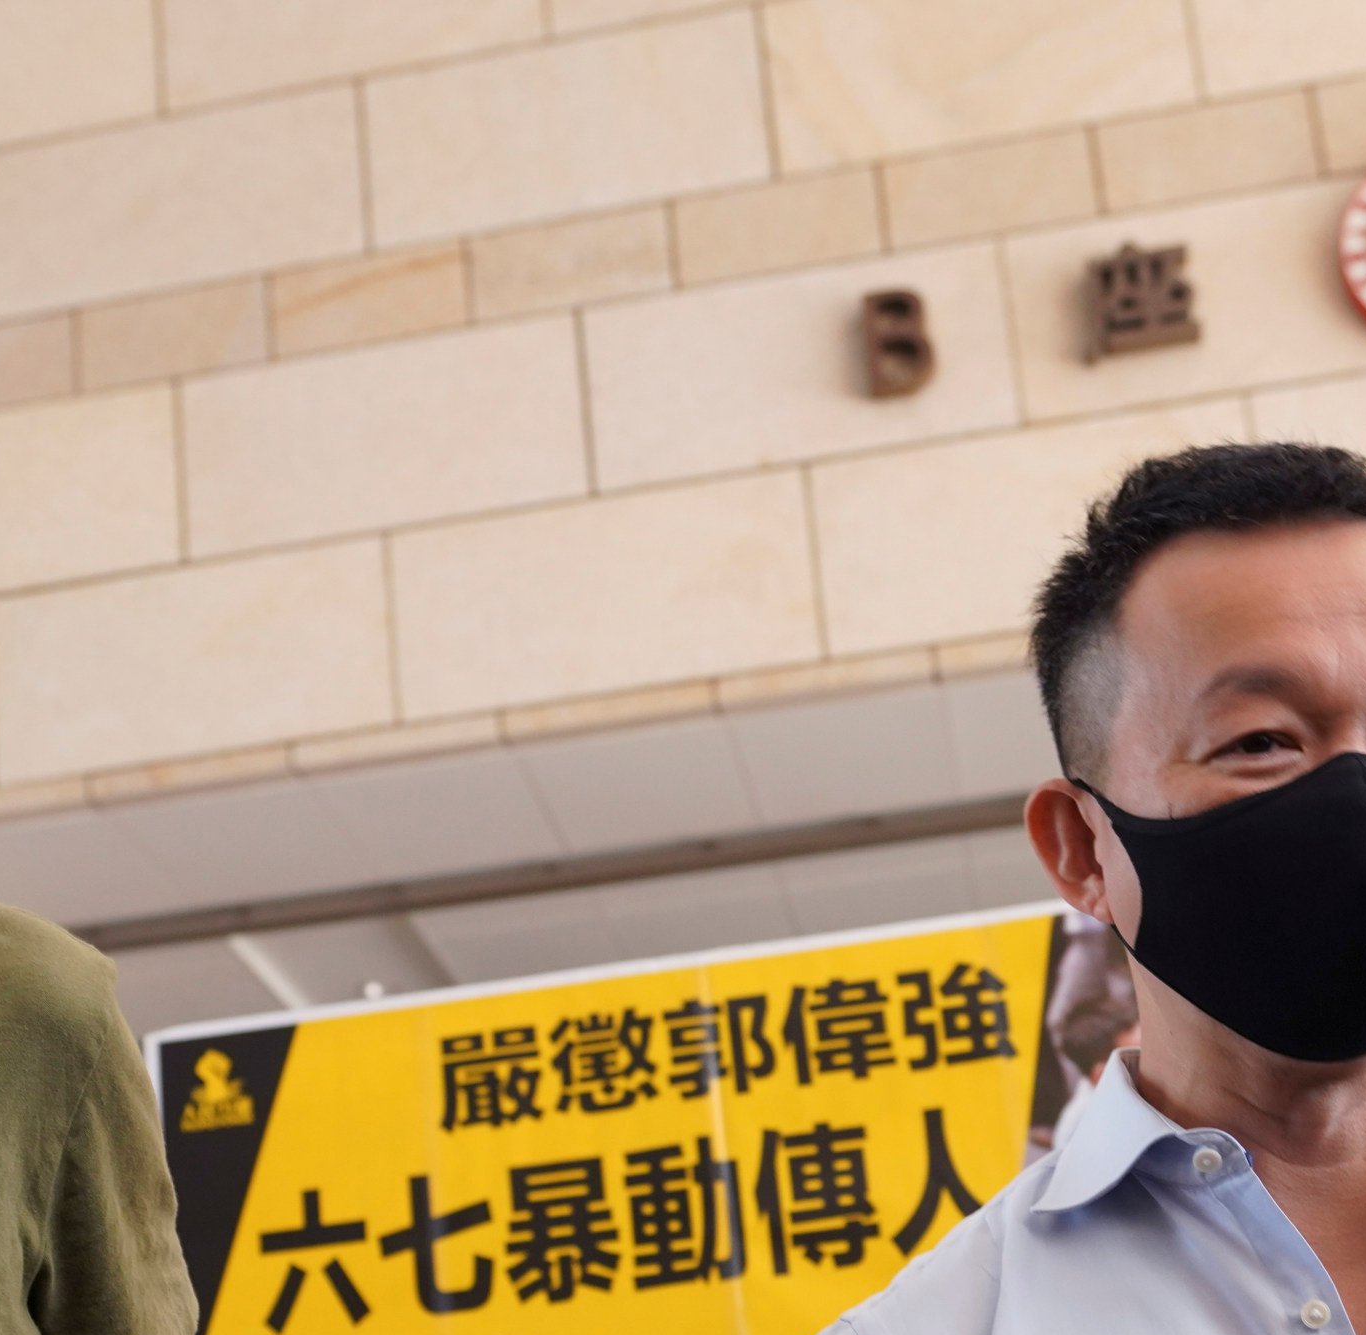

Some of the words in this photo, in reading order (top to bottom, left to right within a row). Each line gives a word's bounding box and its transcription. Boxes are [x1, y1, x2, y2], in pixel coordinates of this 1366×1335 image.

[861, 287, 936, 398] B
[1081, 240, 1202, 365] 座
[439, 961, 1019, 1134] 嚴懲郭偉強
